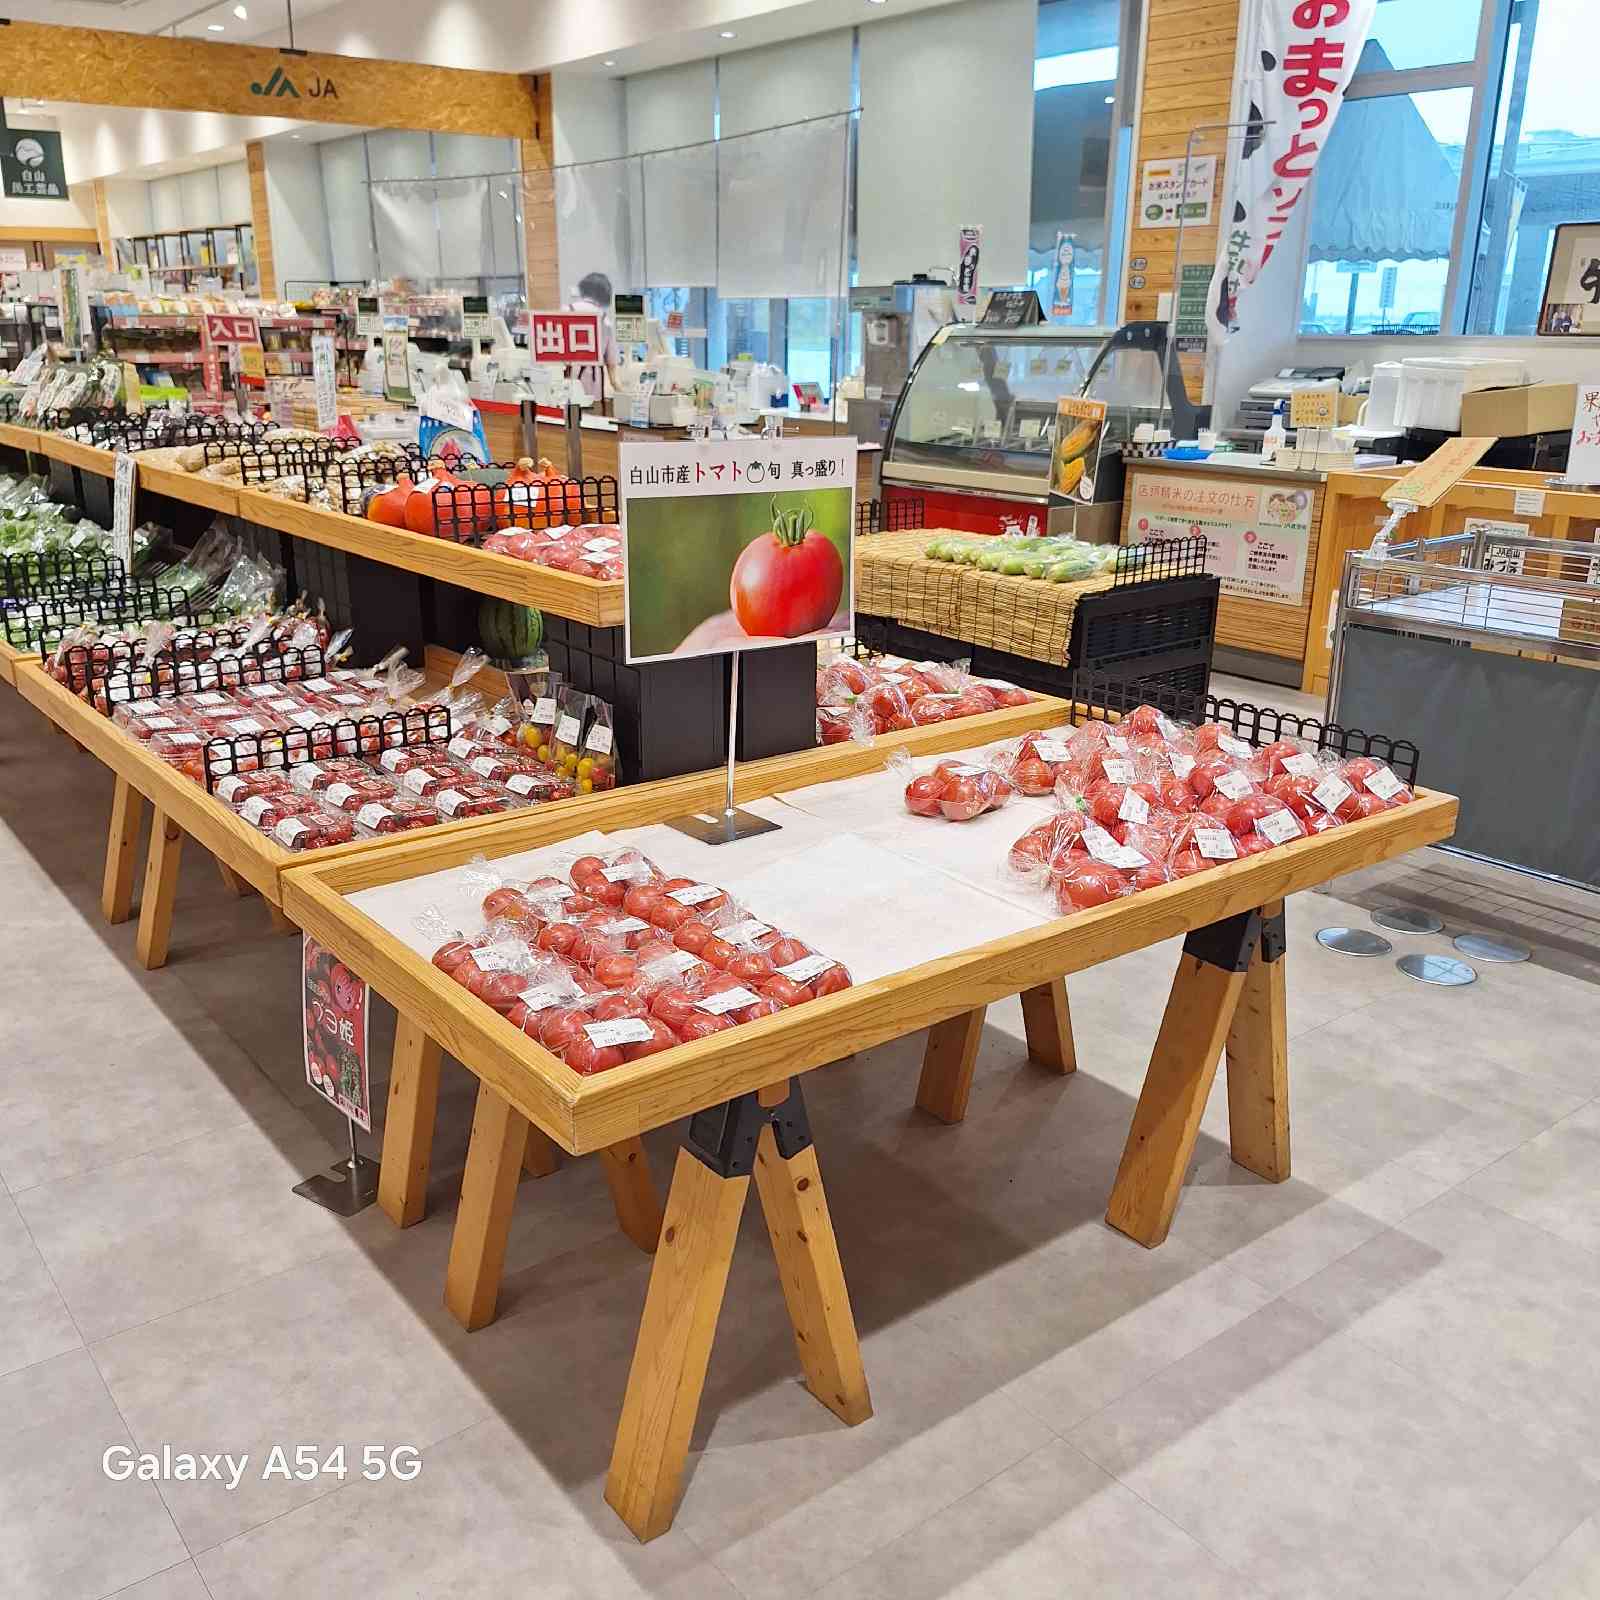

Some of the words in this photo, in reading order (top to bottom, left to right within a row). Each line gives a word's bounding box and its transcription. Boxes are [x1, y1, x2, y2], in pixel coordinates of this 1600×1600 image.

[308, 76, 339, 99] JA
[211, 319, 255, 339] 入口
[535, 320, 596, 354] 出口
[630, 461, 743, 485] 白山市産トマト
